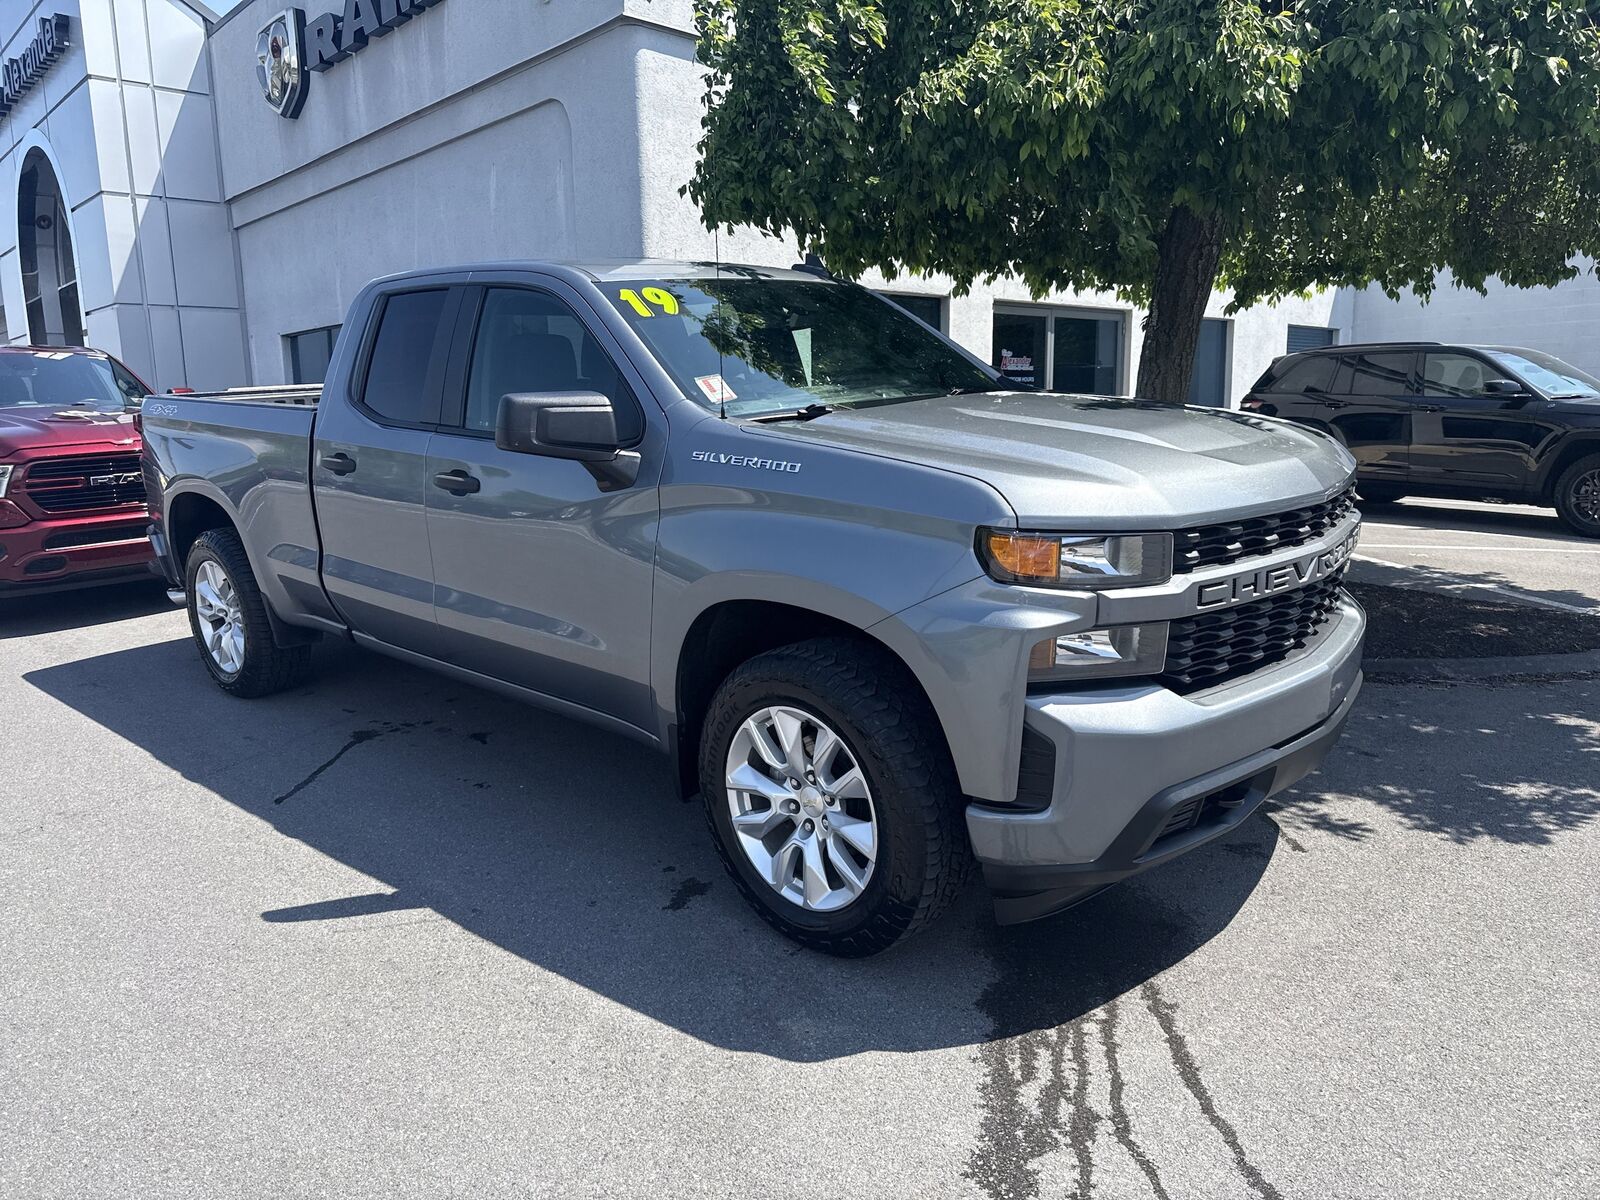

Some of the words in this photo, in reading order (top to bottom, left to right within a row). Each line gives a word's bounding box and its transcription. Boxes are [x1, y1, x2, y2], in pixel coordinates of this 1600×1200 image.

[2, 13, 62, 106] Alexander
[619, 286, 680, 318] 19
[691, 450, 802, 474] SILVERADO
[90, 471, 143, 486] RA
[1196, 525, 1360, 610] CHEVROLE
